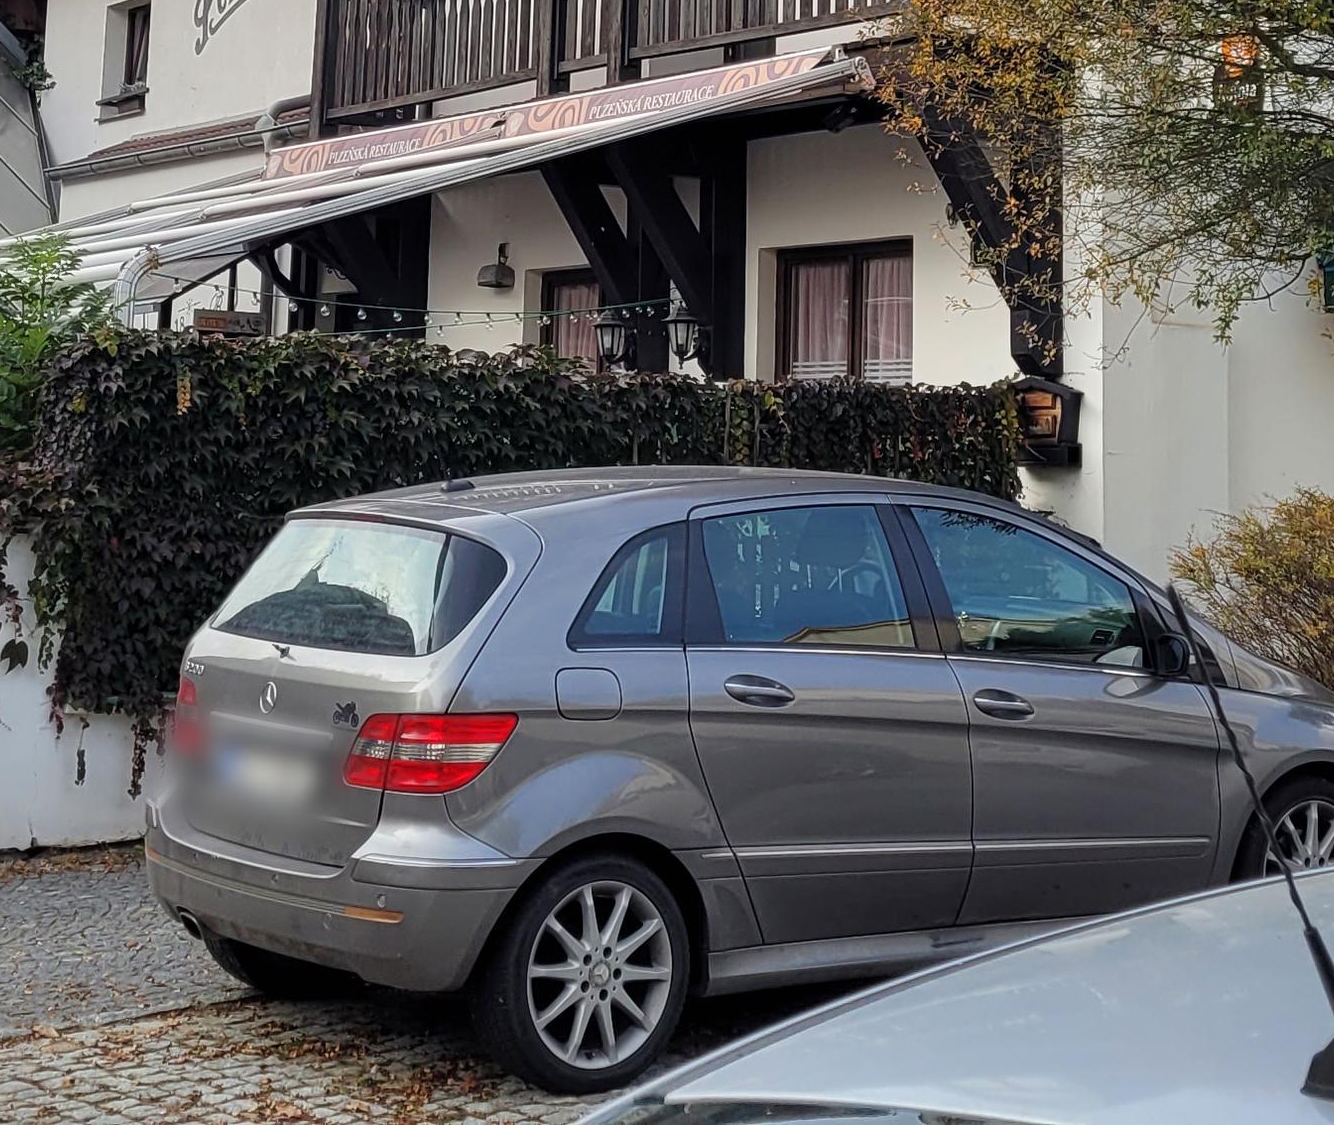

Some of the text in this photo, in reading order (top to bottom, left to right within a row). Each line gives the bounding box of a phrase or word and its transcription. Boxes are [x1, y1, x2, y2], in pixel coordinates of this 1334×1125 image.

[589, 85, 715, 120] PLZEŇSKÁ RESTAURACE
[328, 138, 422, 165] PLZEŇSKÁ RESTAURACE
